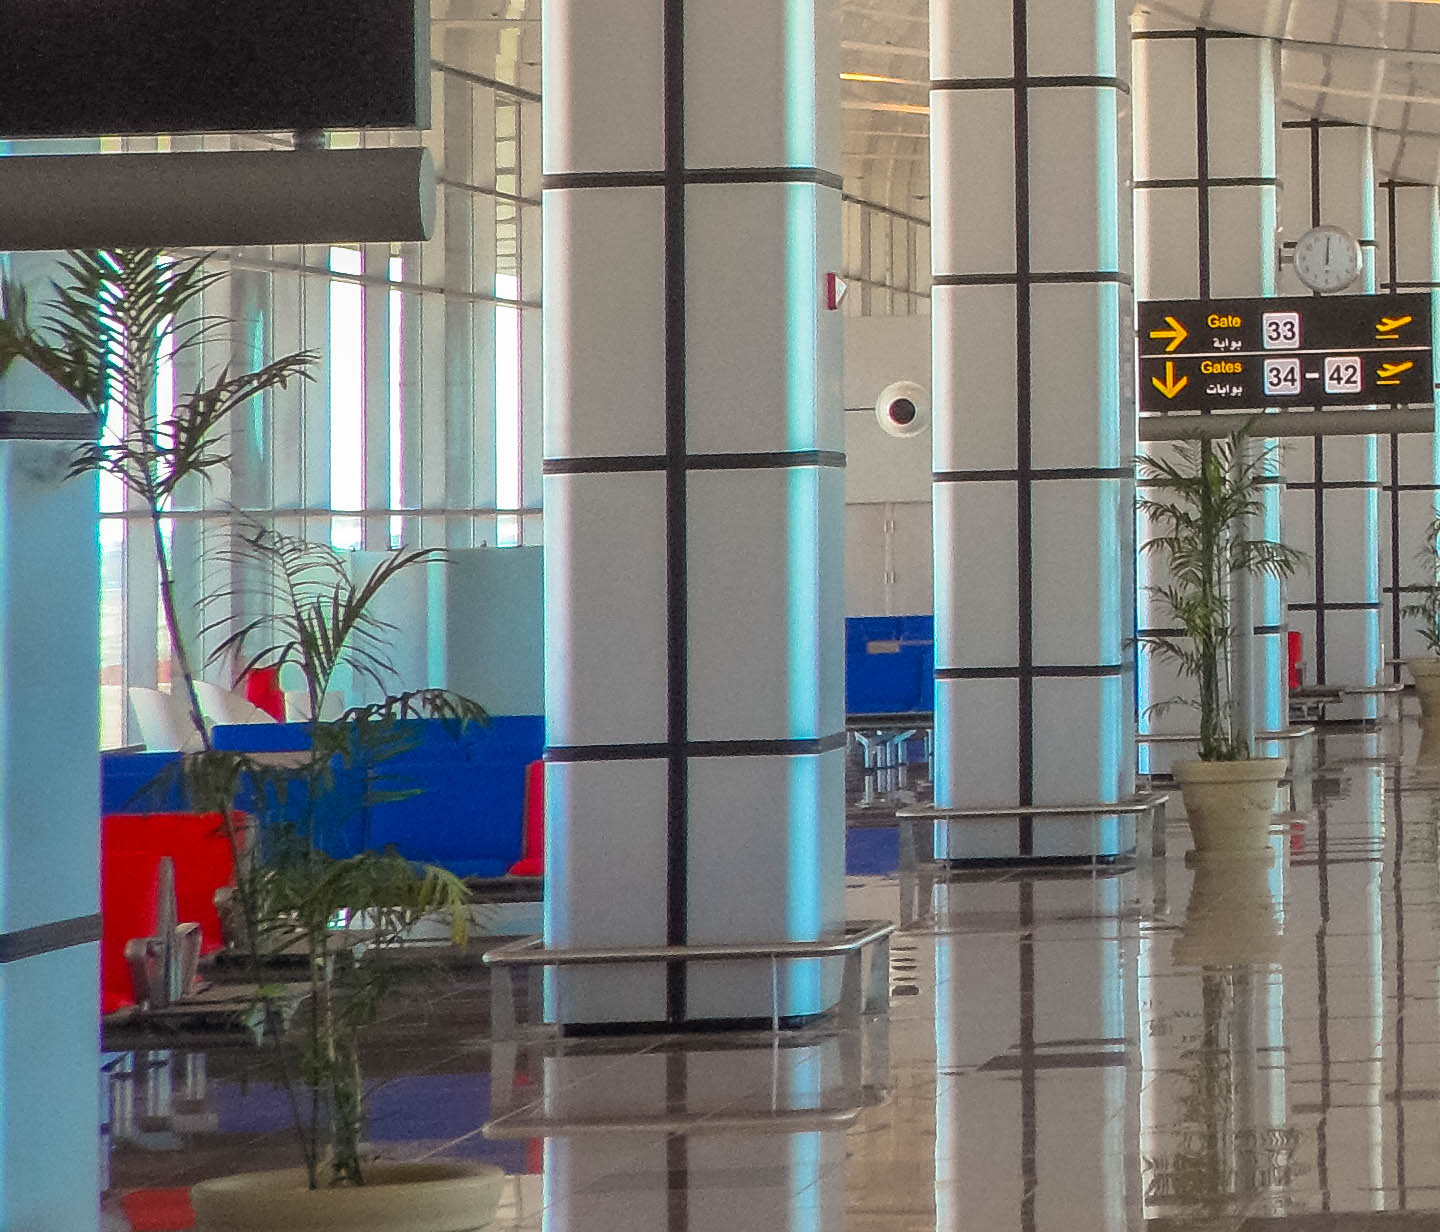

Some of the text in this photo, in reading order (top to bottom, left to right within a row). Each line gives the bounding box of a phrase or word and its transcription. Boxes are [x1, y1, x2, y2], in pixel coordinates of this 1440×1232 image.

[1208, 314, 1241, 328] Gate
[1267, 321, 1296, 341] 33
[1212, 337, 1242, 351] بوابة
[1201, 360, 1242, 374] Gates
[1268, 366, 1297, 387] 34
[1328, 364, 1358, 385] 42
[1206, 383, 1243, 397] بوابات
